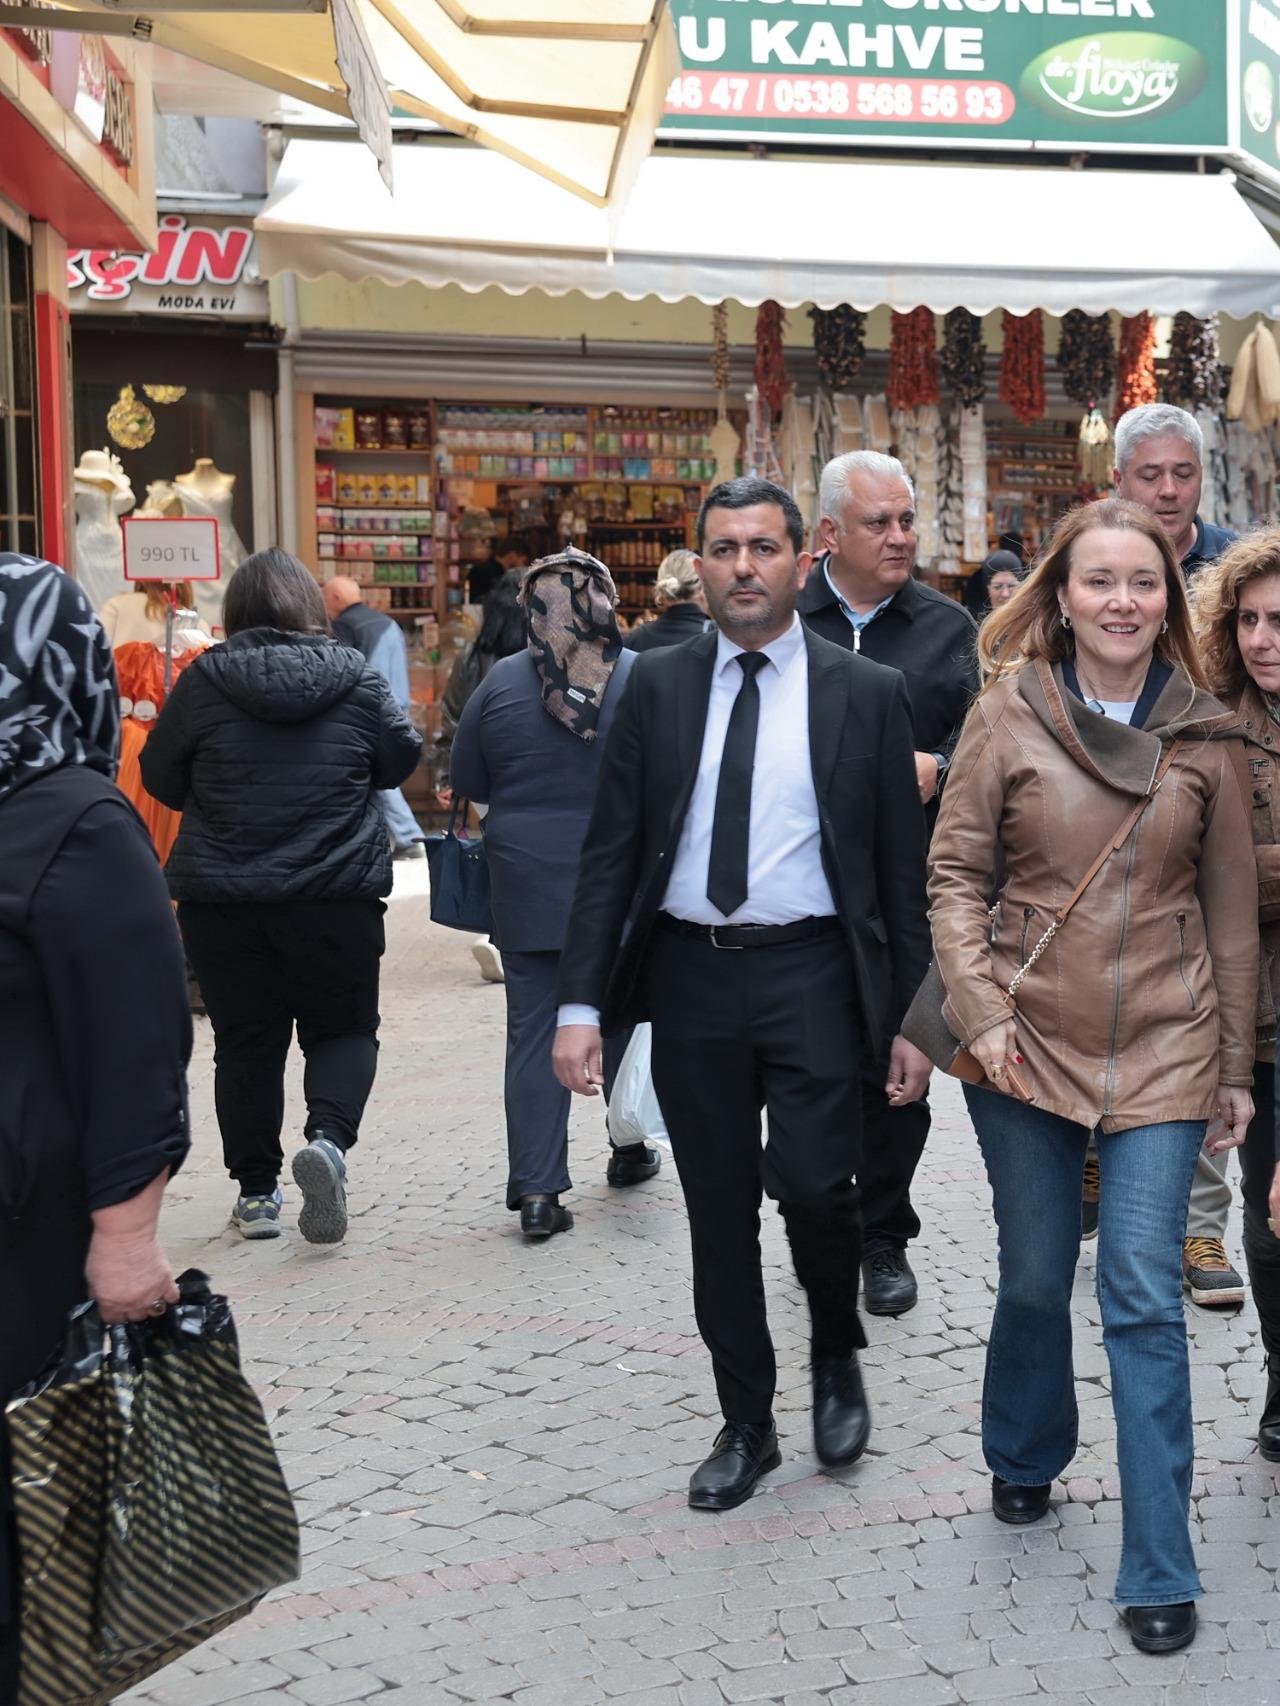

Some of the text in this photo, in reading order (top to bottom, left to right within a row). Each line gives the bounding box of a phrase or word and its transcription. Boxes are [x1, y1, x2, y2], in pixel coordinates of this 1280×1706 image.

[750, 19, 984, 71] KAHVE
[1067, 40, 1170, 106] floya
[709, 77, 749, 111] 47
[773, 79, 849, 114] 0538
[857, 82, 913, 117] 568
[921, 84, 958, 118] 56
[965, 86, 1003, 119] 93
[67, 215, 254, 300] ÇİN
[158, 295, 236, 310] MODA EVİ
[140, 546, 201, 562] 990 TL
